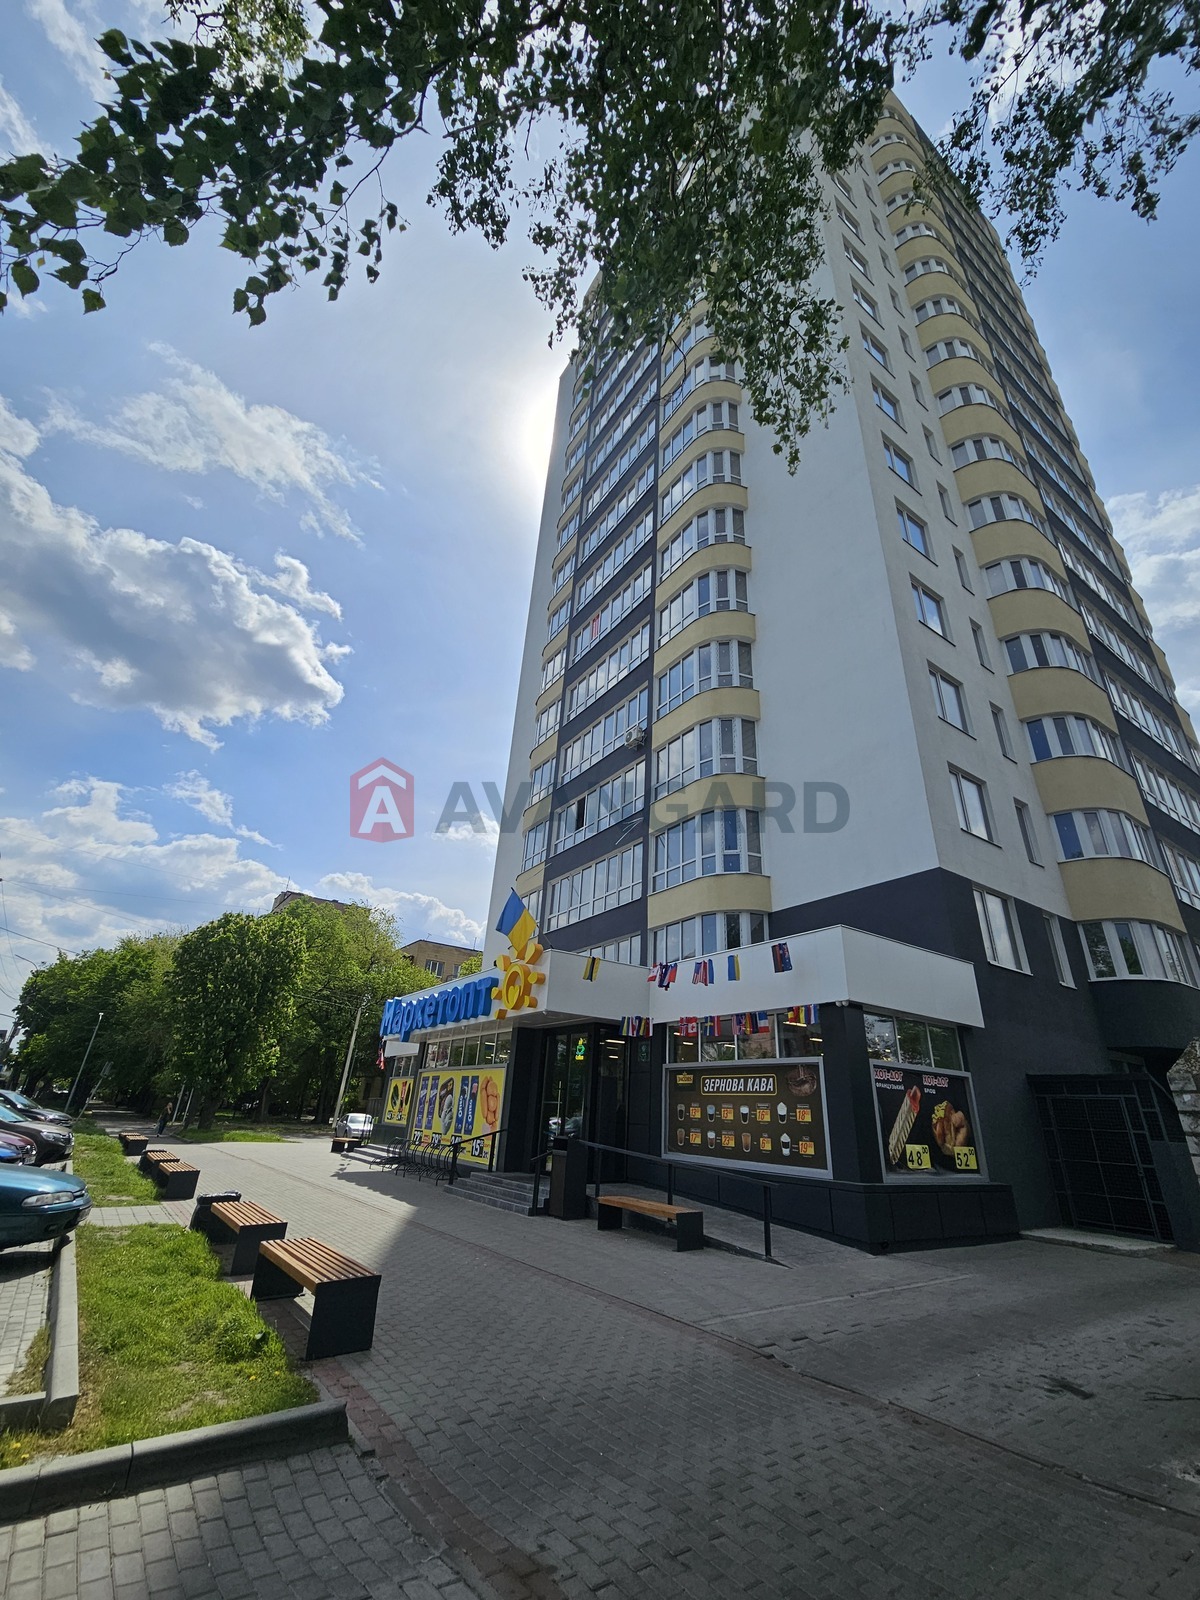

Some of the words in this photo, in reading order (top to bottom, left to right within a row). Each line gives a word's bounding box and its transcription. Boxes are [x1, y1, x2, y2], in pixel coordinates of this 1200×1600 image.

[380, 977, 498, 1042] Маркетопт
[874, 1069, 903, 1082] ХОТ-ДОГ
[922, 1074, 949, 1088] ХОТ-ДОГ
[704, 1078, 744, 1092] ЗЕРНОВА
[746, 1077, 774, 1092] КАВА
[908, 1150, 922, 1167] 48
[956, 1152, 969, 1168] 52
